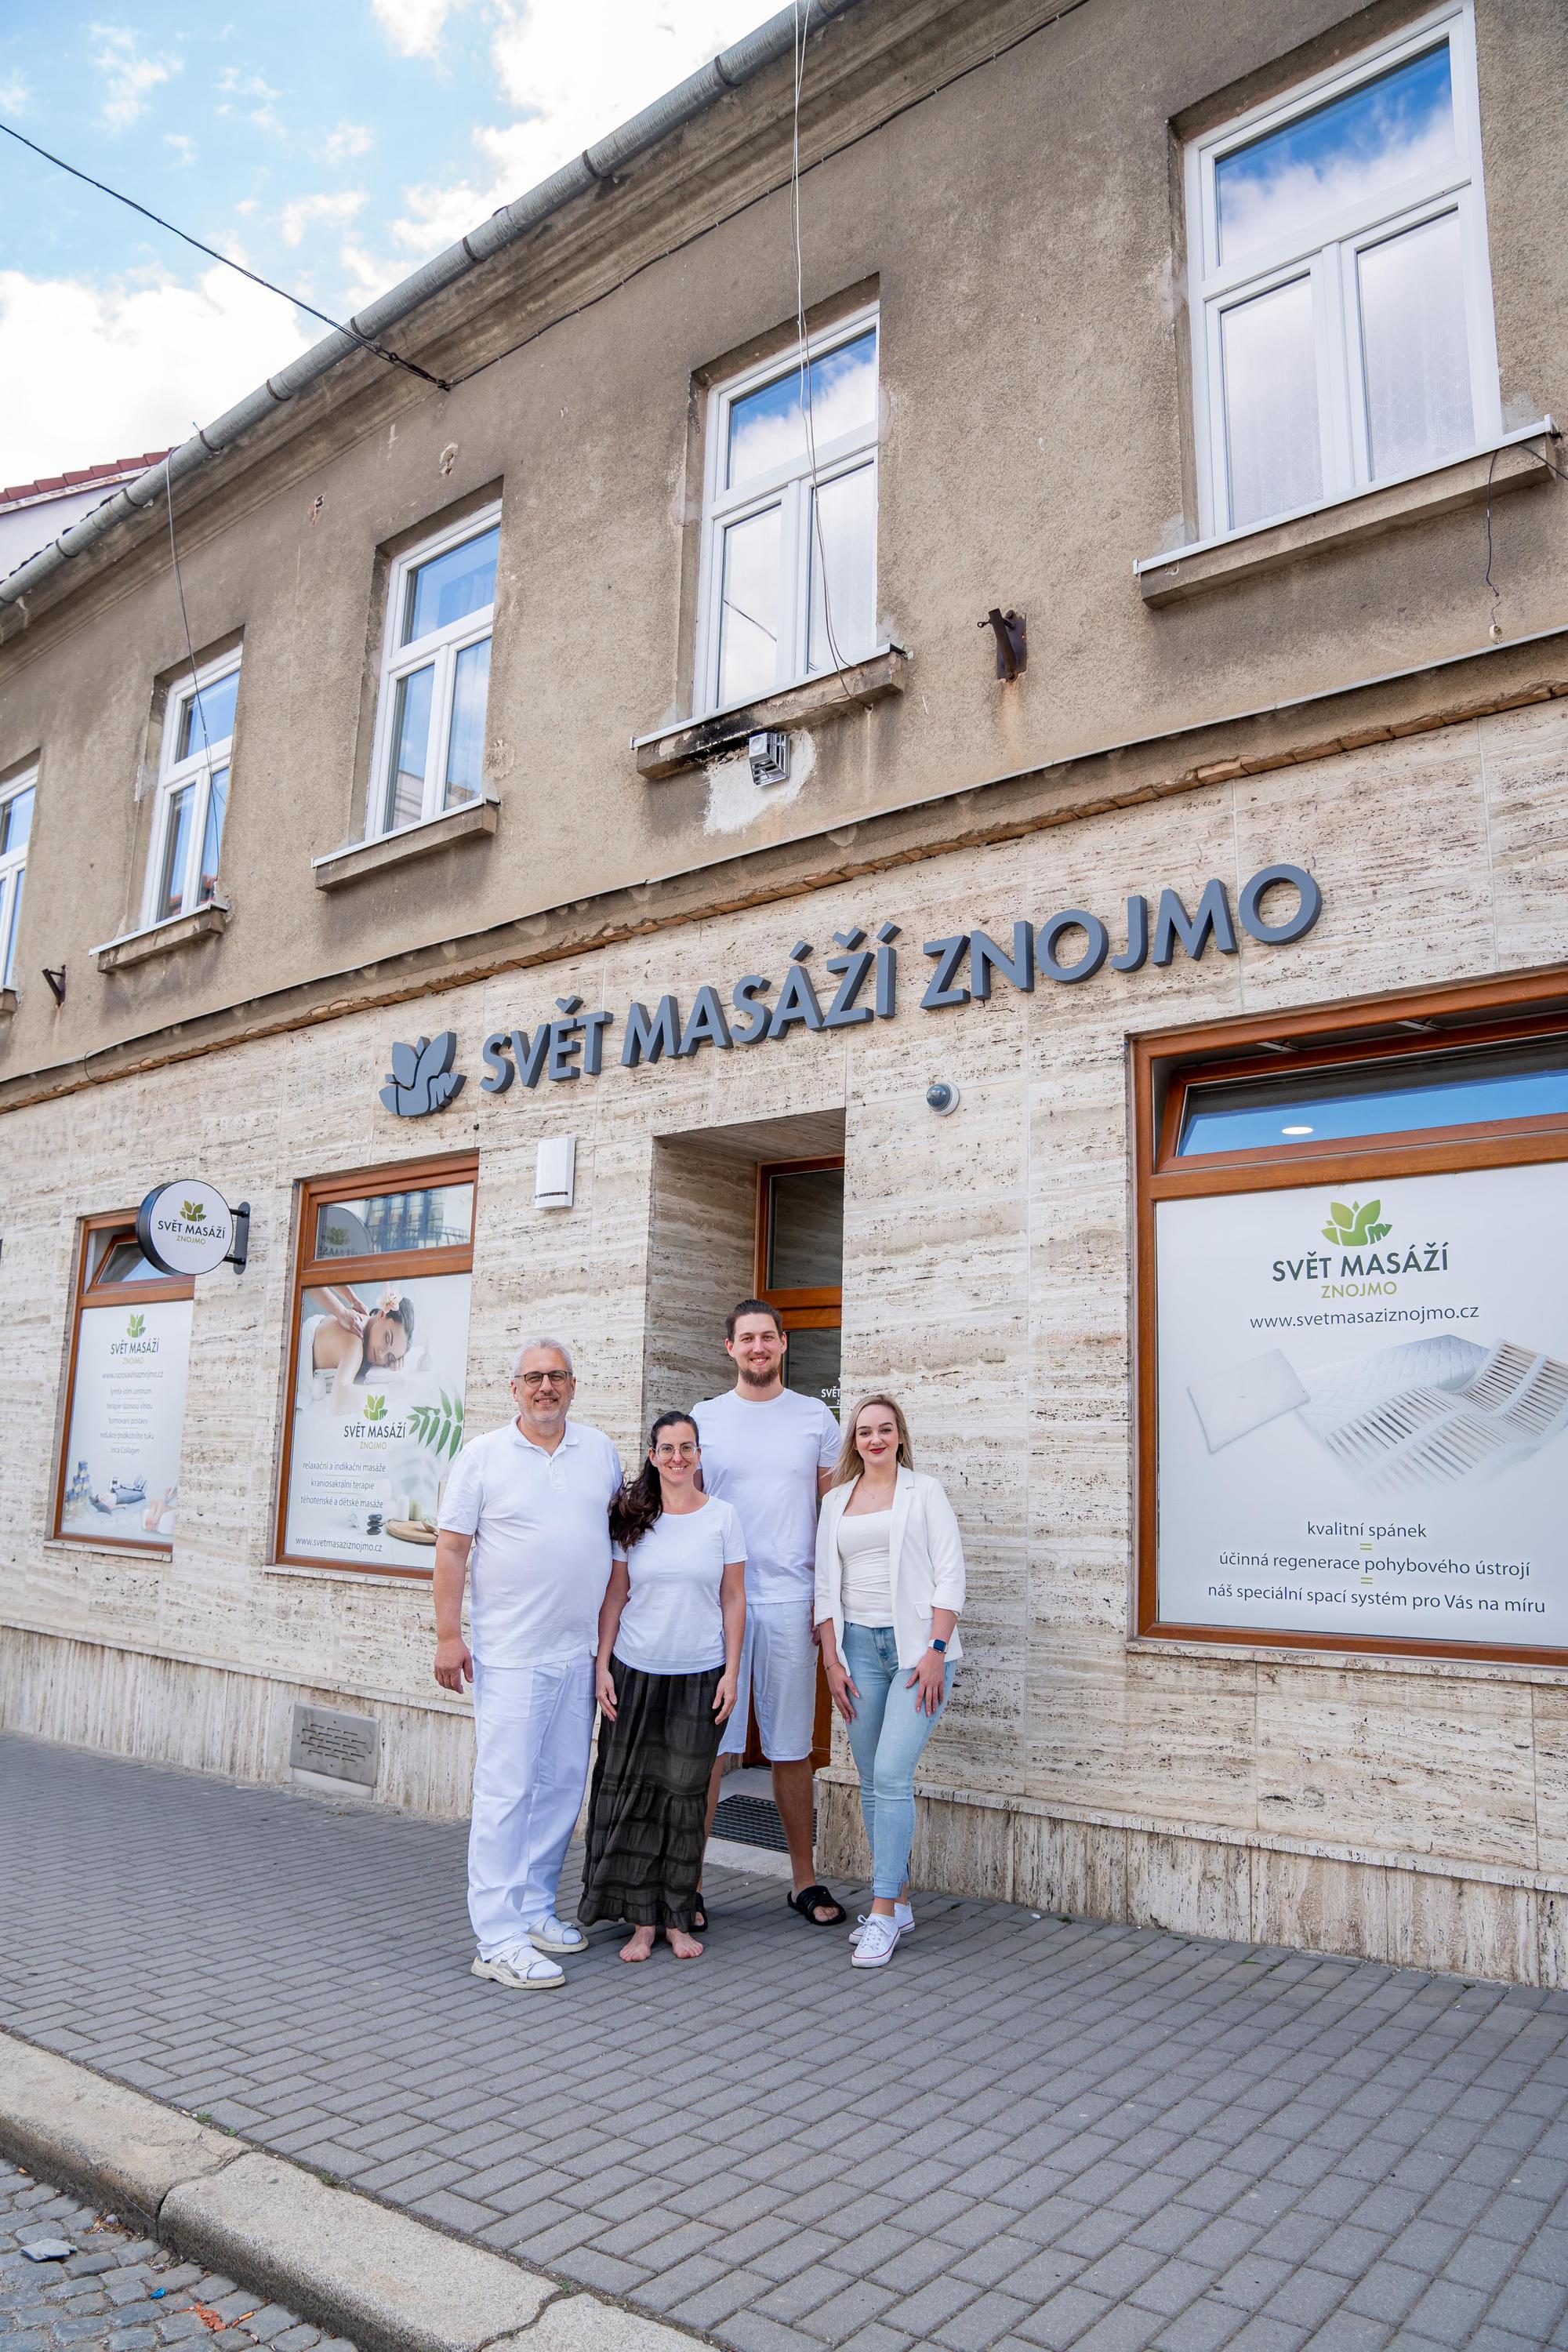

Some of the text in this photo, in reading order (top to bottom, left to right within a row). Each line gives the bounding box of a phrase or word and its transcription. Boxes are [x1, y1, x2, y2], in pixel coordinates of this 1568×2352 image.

[480, 864, 1323, 1094] SVĚT MASÁŽÍ ZNOJMO
[158, 1219, 226, 1239] SVĚT MASÁŽÍ
[176, 1235, 205, 1245] ZNOJMO
[1272, 1242, 1449, 1282] SVĚT MASÁŽÍ
[1321, 1281, 1397, 1299] ZNOJMO
[1250, 1305, 1479, 1329] www.svetmasaziznojmo.cz
[111, 1338, 160, 1355] SVĚT MASÁŽÍ
[343, 1421, 406, 1438] SVĚT MASÁŽÍ
[360, 1441, 387, 1450] ZNOJMO
[303, 1461, 328, 1470] relaxační
[334, 1461, 361, 1472] indikační
[362, 1463, 386, 1472] masáže
[310, 1478, 375, 1491] kraniosakrální terapie
[300, 1495, 333, 1505] těhotenské
[339, 1497, 359, 1507] dětské
[361, 1498, 383, 1508] masáže
[1307, 1521, 1427, 1540] kvalitní spánek
[296, 1537, 383, 1552] www.svetmasaziznojmo.cz
[1220, 1552, 1530, 1580] účinná regenerace pohybového ústrojí
[1208, 1584, 1545, 1613] náš speciální spací systém pro Vás na míru
